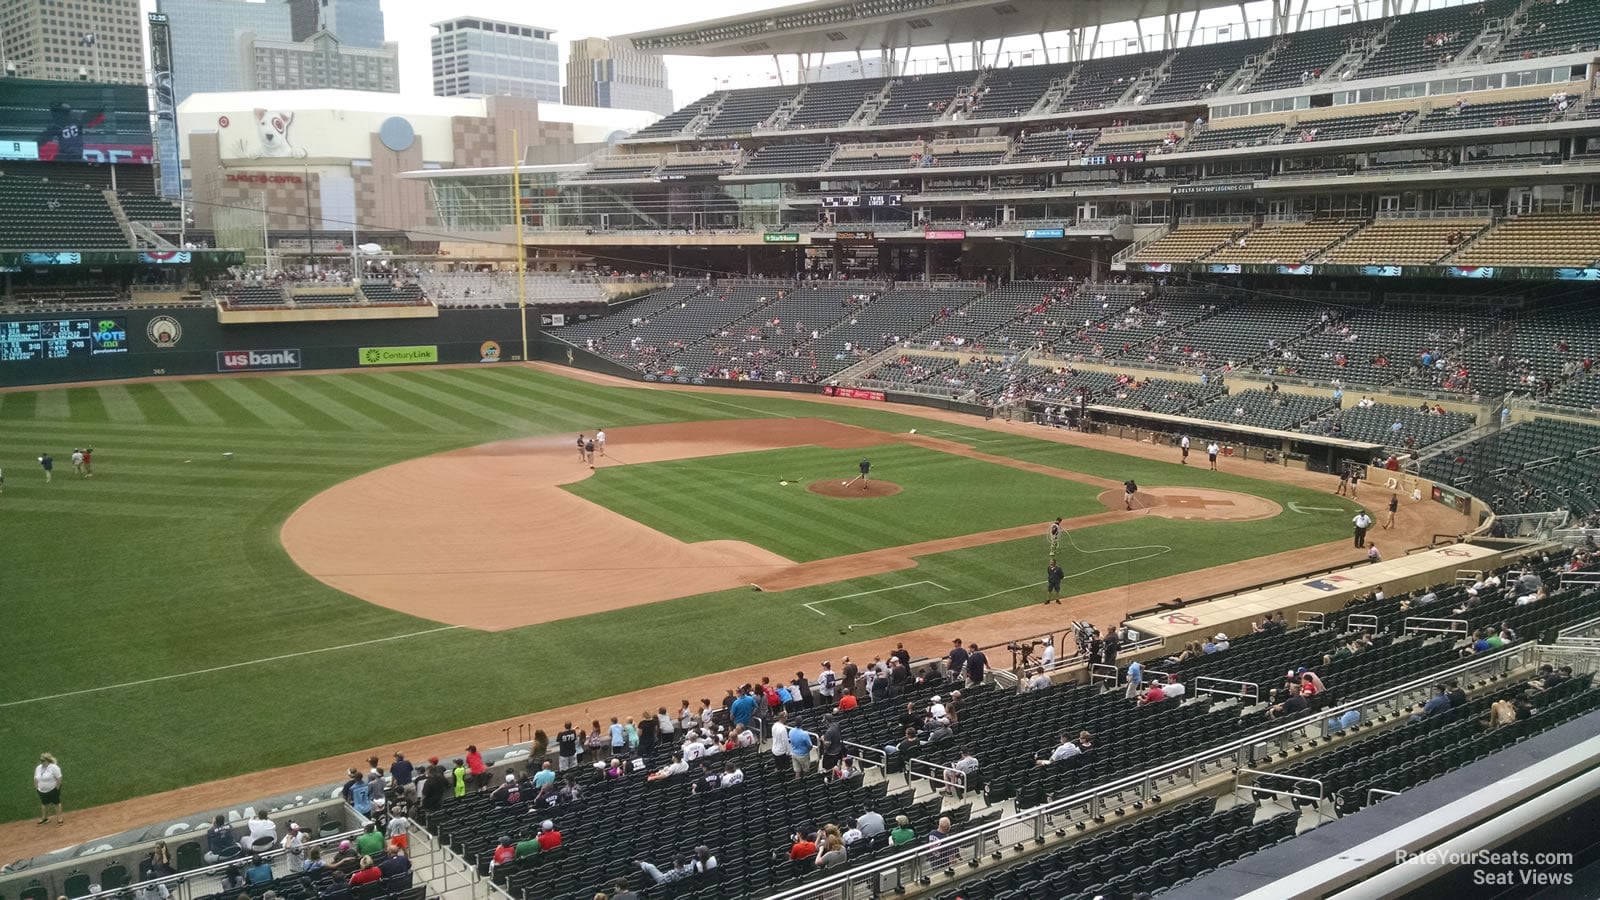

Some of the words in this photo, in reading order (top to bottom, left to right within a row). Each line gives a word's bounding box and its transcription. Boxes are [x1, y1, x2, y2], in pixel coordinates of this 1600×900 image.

[225, 174, 260, 182] TARGET
[268, 175, 302, 184] CENTER
[98, 320, 115, 332] go
[92, 331, 126, 342] VOTE
[383, 351, 431, 361] CenturyLink
